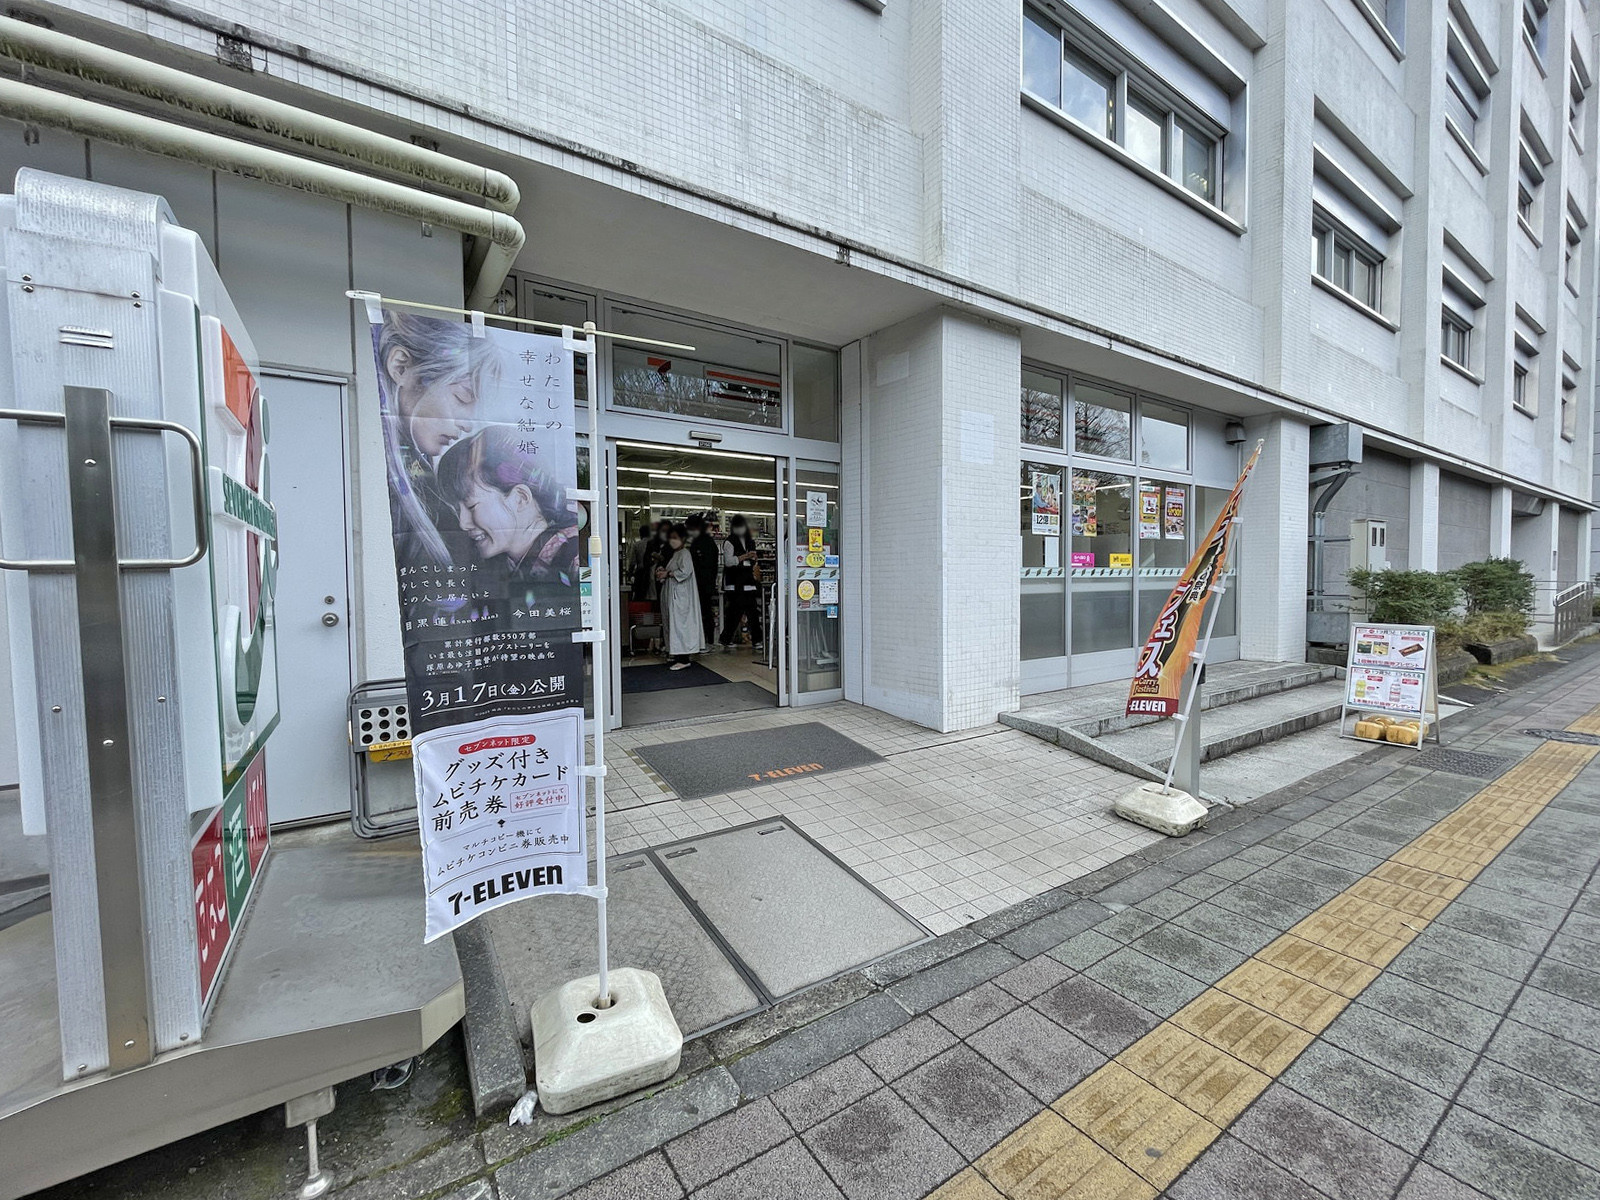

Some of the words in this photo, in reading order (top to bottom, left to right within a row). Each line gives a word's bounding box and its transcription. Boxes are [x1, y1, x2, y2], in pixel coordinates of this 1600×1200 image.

[517, 350, 538, 455] 幸せな結婚
[545, 352, 563, 431] わたしの
[512, 607, 572, 619] 今田美桜
[444, 632, 537, 649] 累計発行部数550万部
[421, 675, 565, 711] 3月17日(金)公開
[465, 736, 531, 753] セブンネット限定
[445, 747, 549, 782] グッズ付き
[432, 765, 569, 808] ムビチケカード
[514, 787, 565, 800] セブンネットにて
[514, 795, 568, 809] 好評受付中!
[431, 796, 508, 832] 前売券
[229, 803, 246, 898] 酒
[437, 834, 570, 877] ムビチケコンビニ券販売中
[463, 827, 542, 851] マルチコピー機にて
